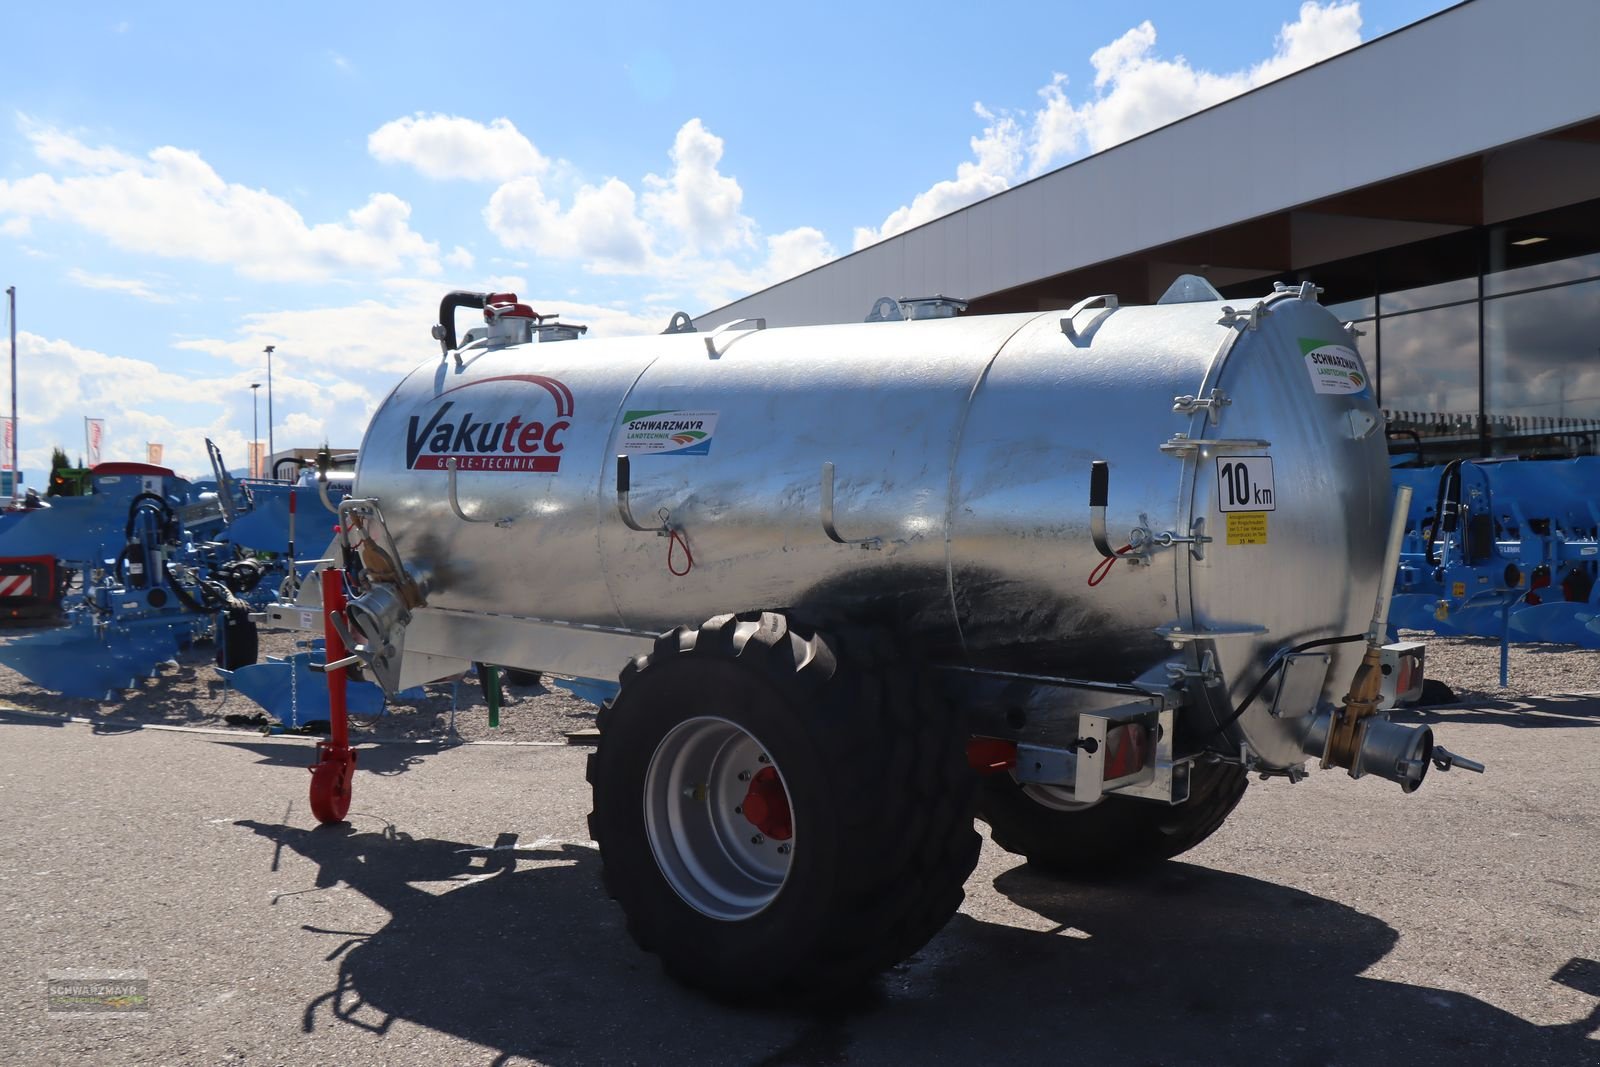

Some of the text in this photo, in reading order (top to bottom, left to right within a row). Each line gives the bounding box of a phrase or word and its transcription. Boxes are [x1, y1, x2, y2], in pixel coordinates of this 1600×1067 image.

[628, 420, 704, 431] SCHWARZMAYR
[406, 401, 571, 470] Vakutec
[626, 432, 670, 440] LANDTECHNIK
[437, 457, 535, 469] GLE-TECHNIK
[1221, 462, 1272, 506] 10 km
